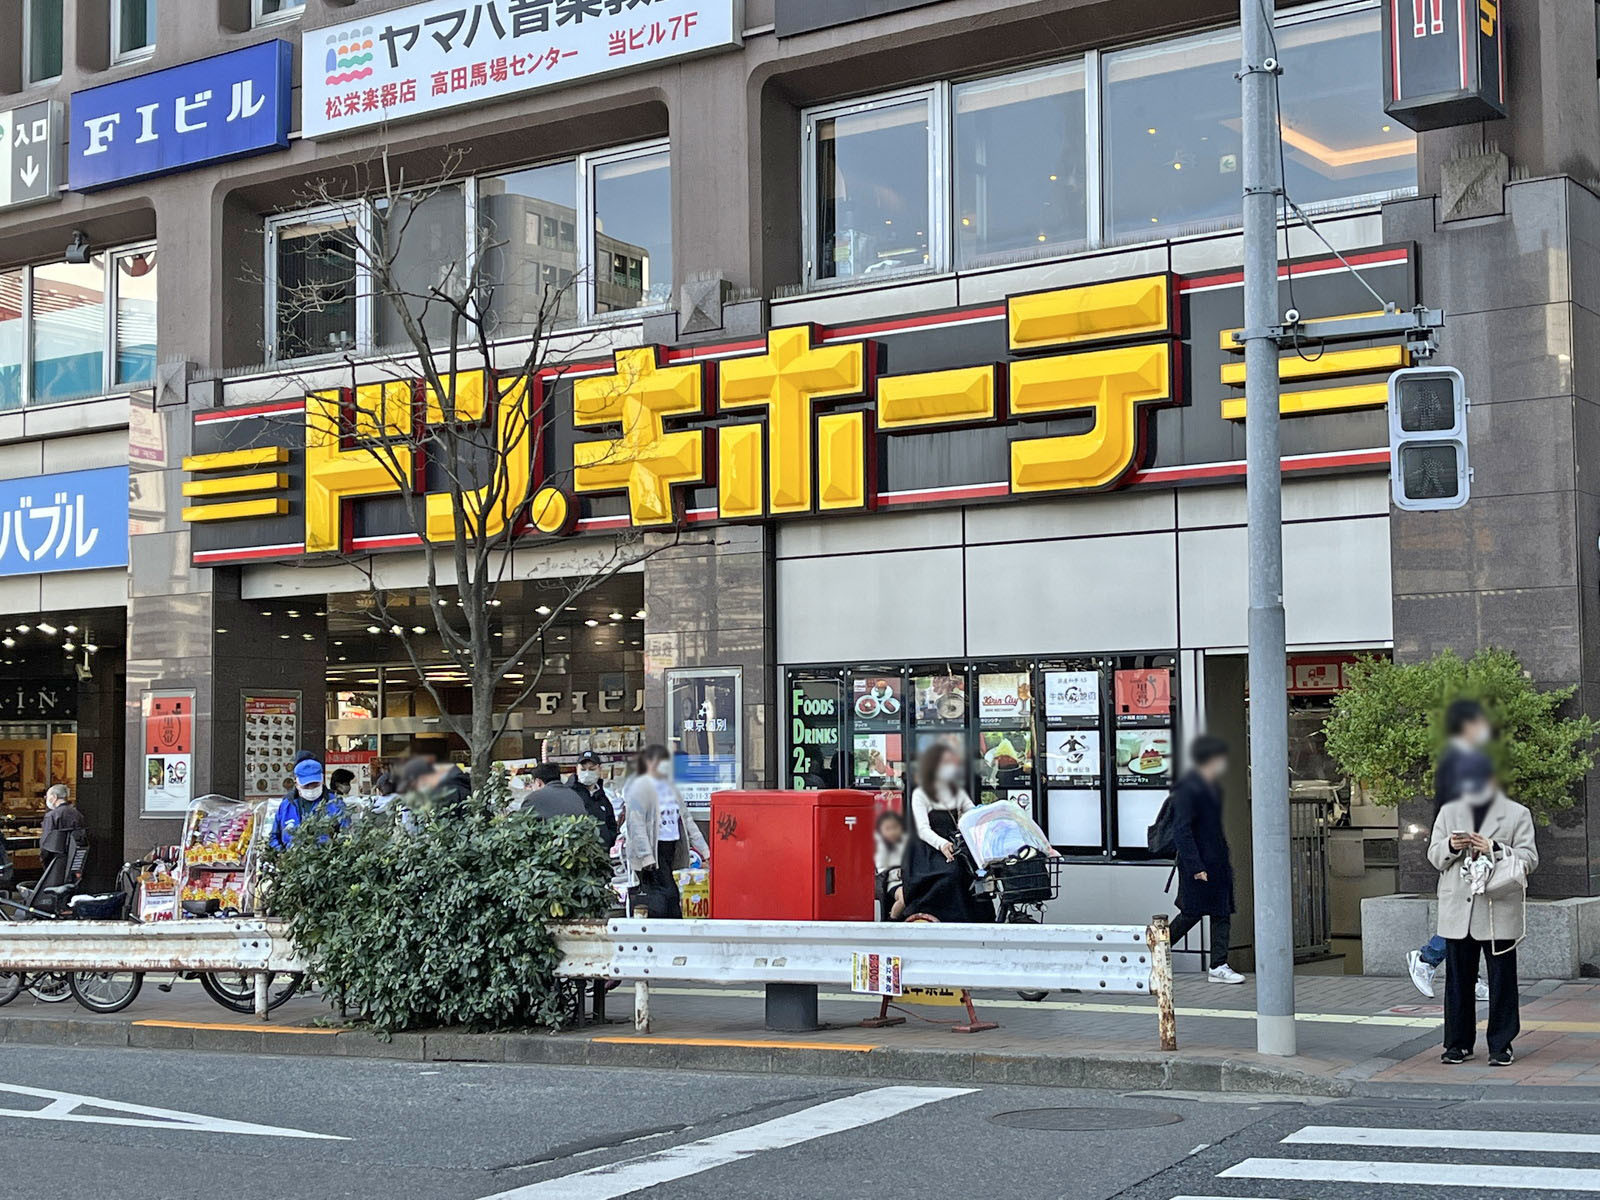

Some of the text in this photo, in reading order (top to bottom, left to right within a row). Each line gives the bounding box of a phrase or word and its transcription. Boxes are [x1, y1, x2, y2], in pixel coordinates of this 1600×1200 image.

[325, 11, 698, 121] 松栄楽器店 高田馬場センター 当ビル7F
[14, 118, 47, 148] 入口
[83, 79, 266, 156] FIビル
[0, 492, 99, 562] バブル
